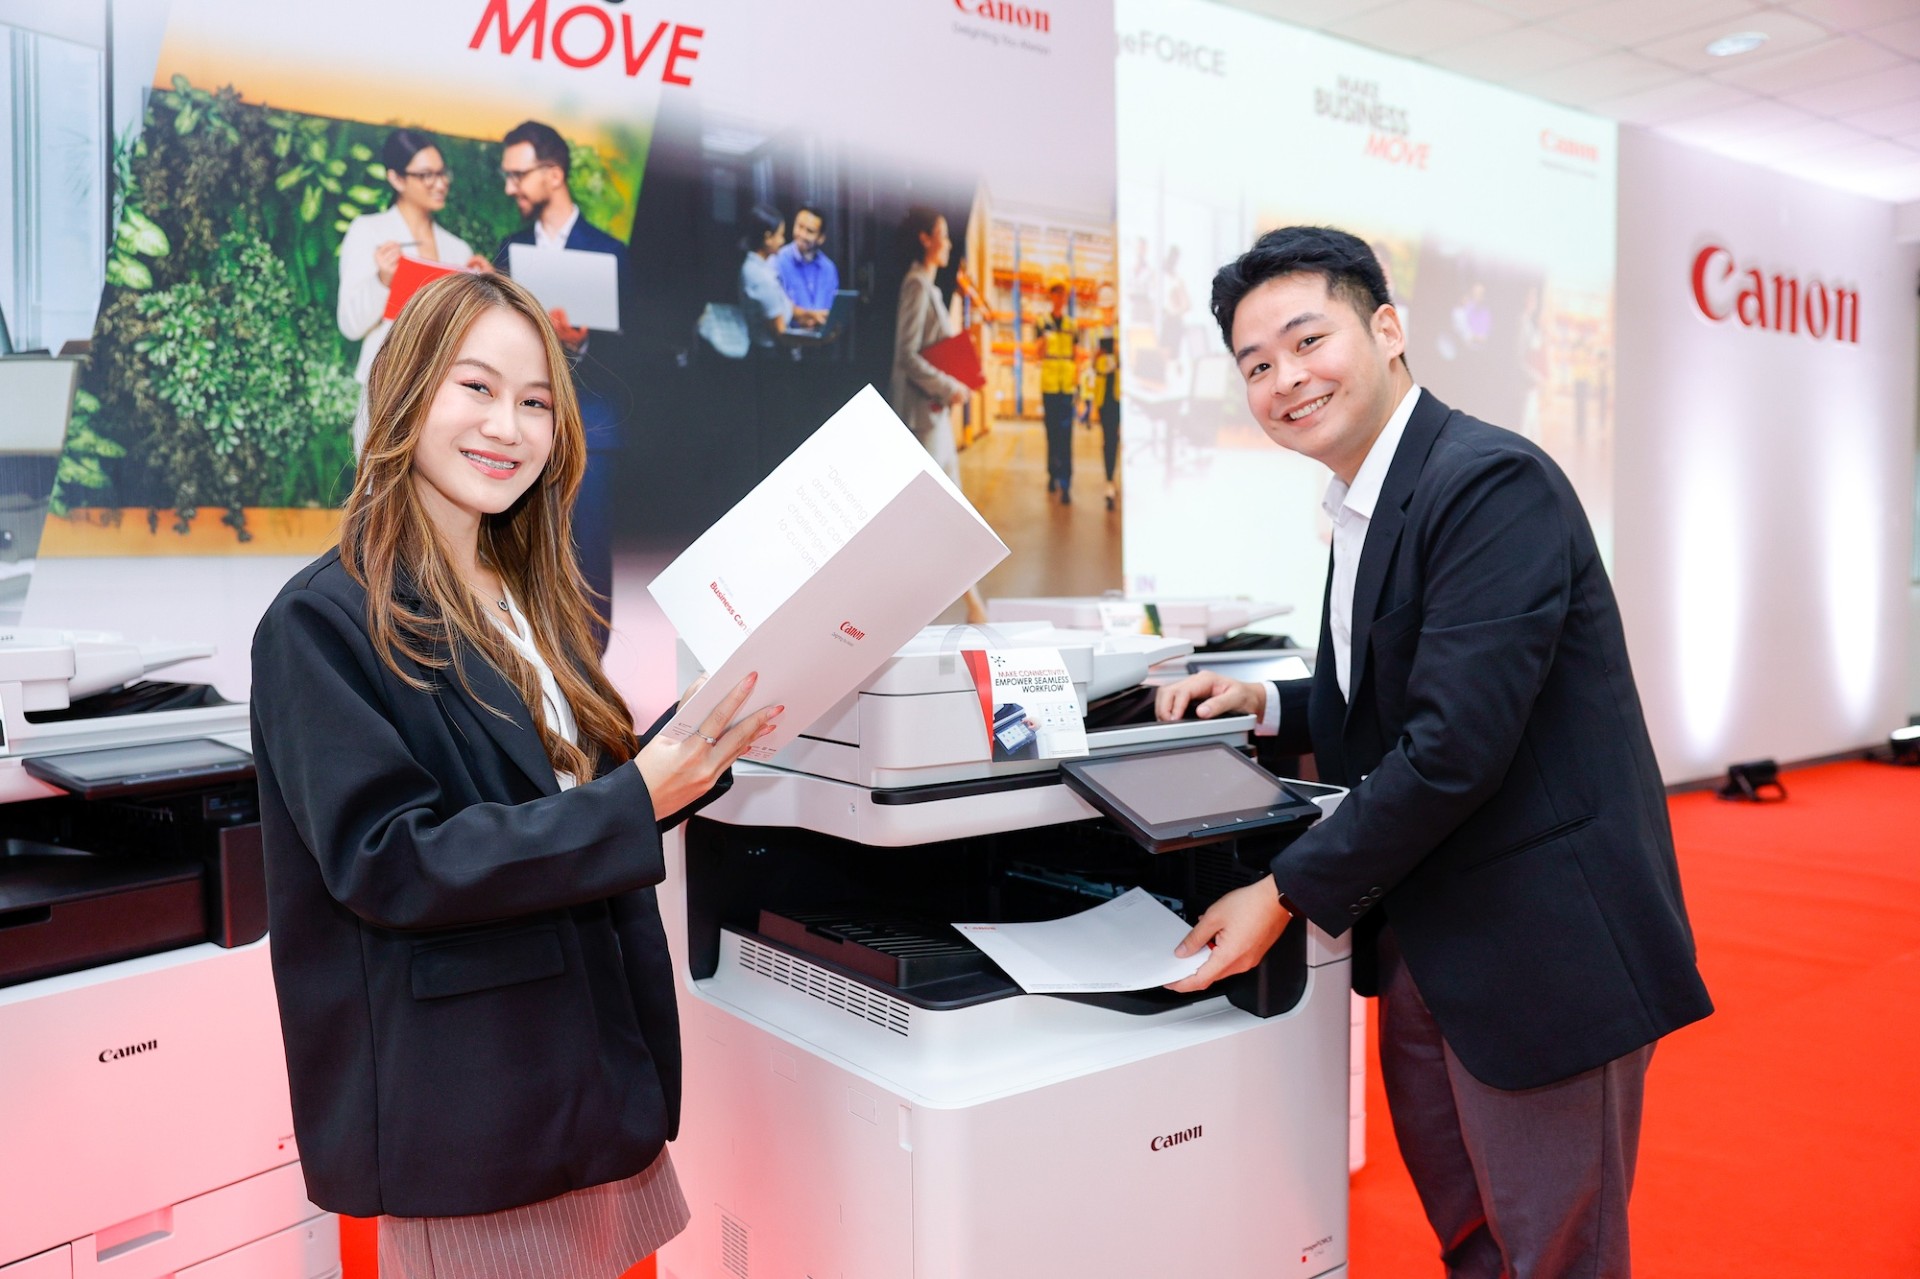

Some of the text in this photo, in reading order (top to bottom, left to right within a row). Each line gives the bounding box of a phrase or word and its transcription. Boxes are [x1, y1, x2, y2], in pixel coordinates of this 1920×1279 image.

[468, 0, 704, 86] MOVE
[1313, 87, 1410, 136] BUSINESS
[1364, 132, 1432, 171] MOVE
[1691, 246, 1858, 343] Canon
[811, 478, 831, 500] and
[795, 485, 829, 527] business
[787, 503, 830, 558] challenges
[709, 581, 735, 615] Business
[840, 621, 865, 641] Canon
[995, 676, 1069, 686] EMPOWER SEAMLESS
[1018, 669, 1065, 677] CONNECTIVITY
[1022, 684, 1064, 693] WORKFLOW
[98, 1039, 157, 1063] Canon
[1151, 1125, 1202, 1151] Canon
